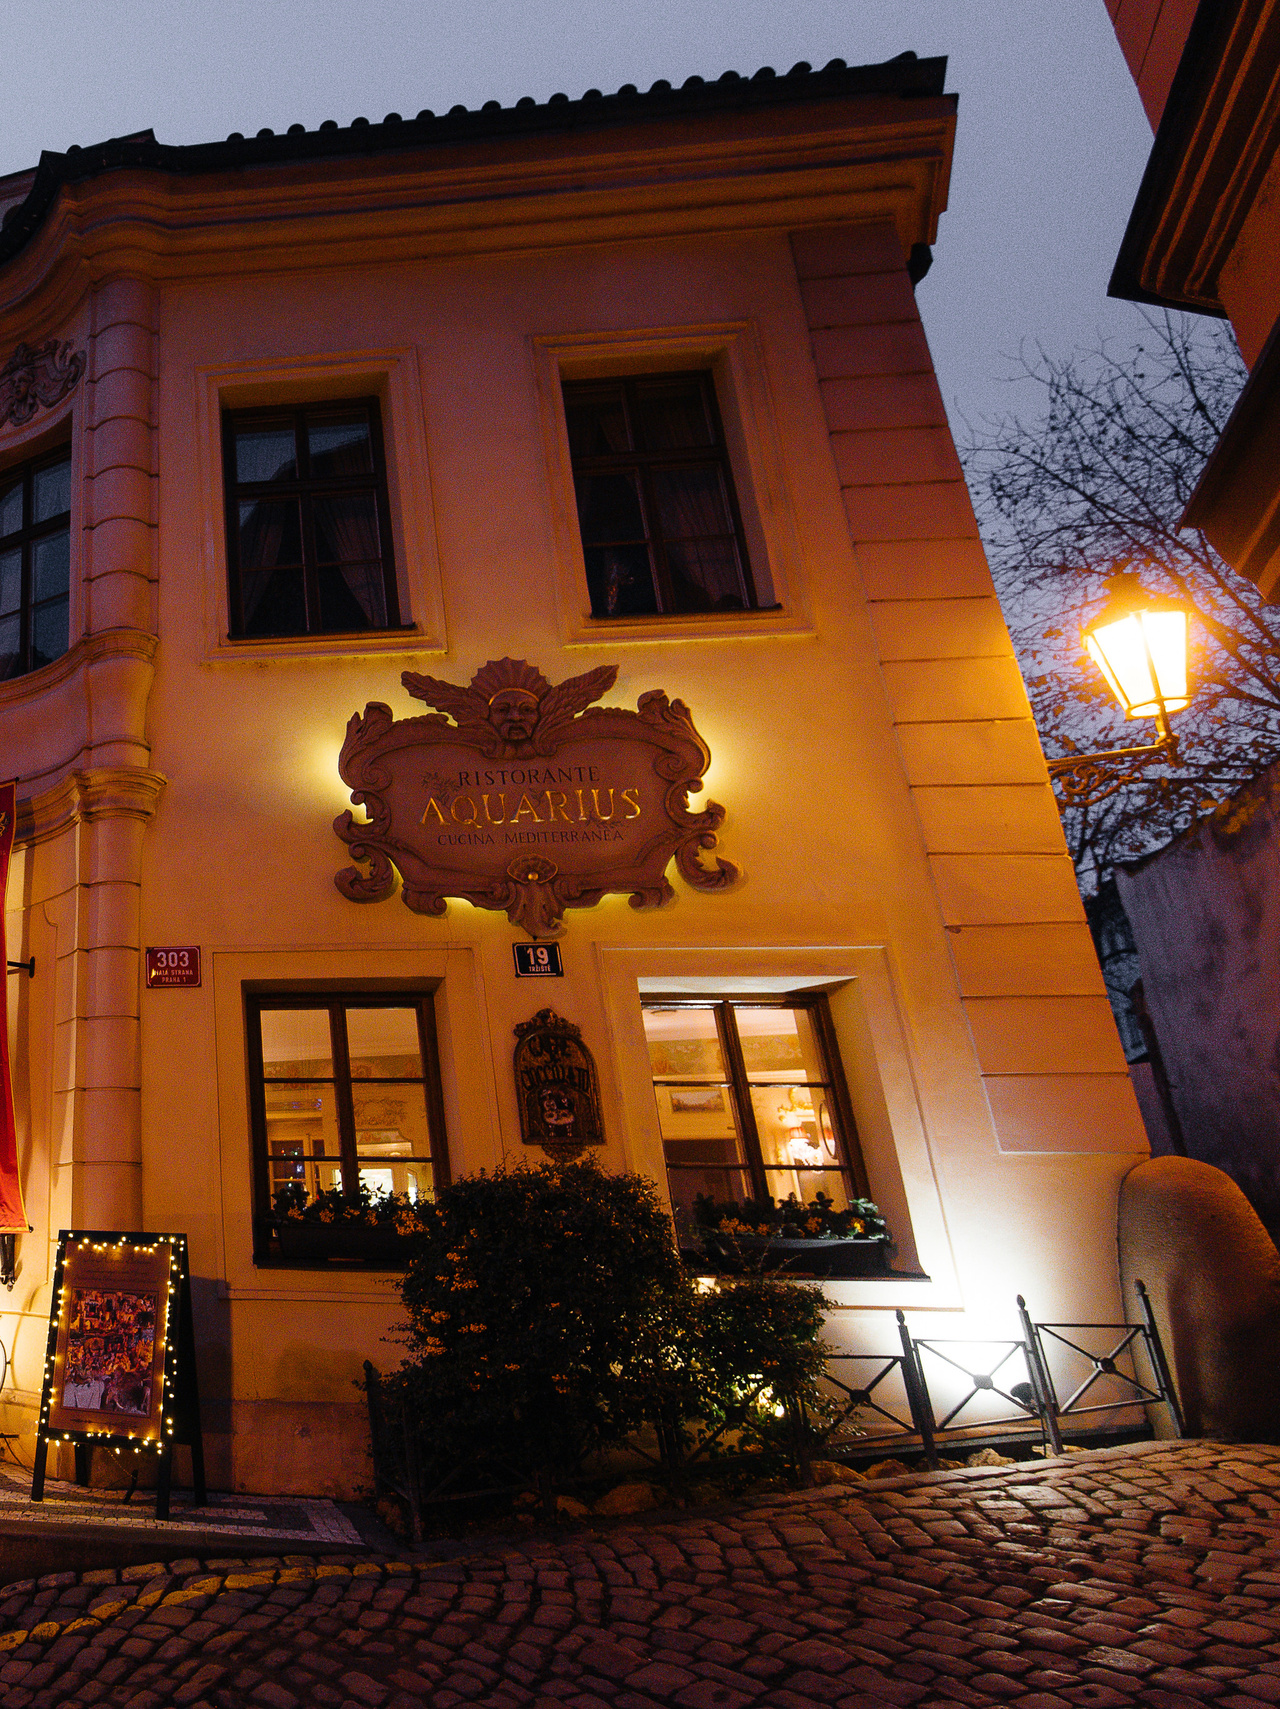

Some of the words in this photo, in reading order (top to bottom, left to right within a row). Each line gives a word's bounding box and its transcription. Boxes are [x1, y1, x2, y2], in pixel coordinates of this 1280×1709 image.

[458, 765, 600, 787] RISTORANTE
[419, 788, 642, 829] AQUARIUS
[437, 833, 495, 847] CUCINA
[504, 829, 624, 845] MEDITERRANEA
[157, 951, 189, 968] 303
[526, 947, 549, 965] 19
